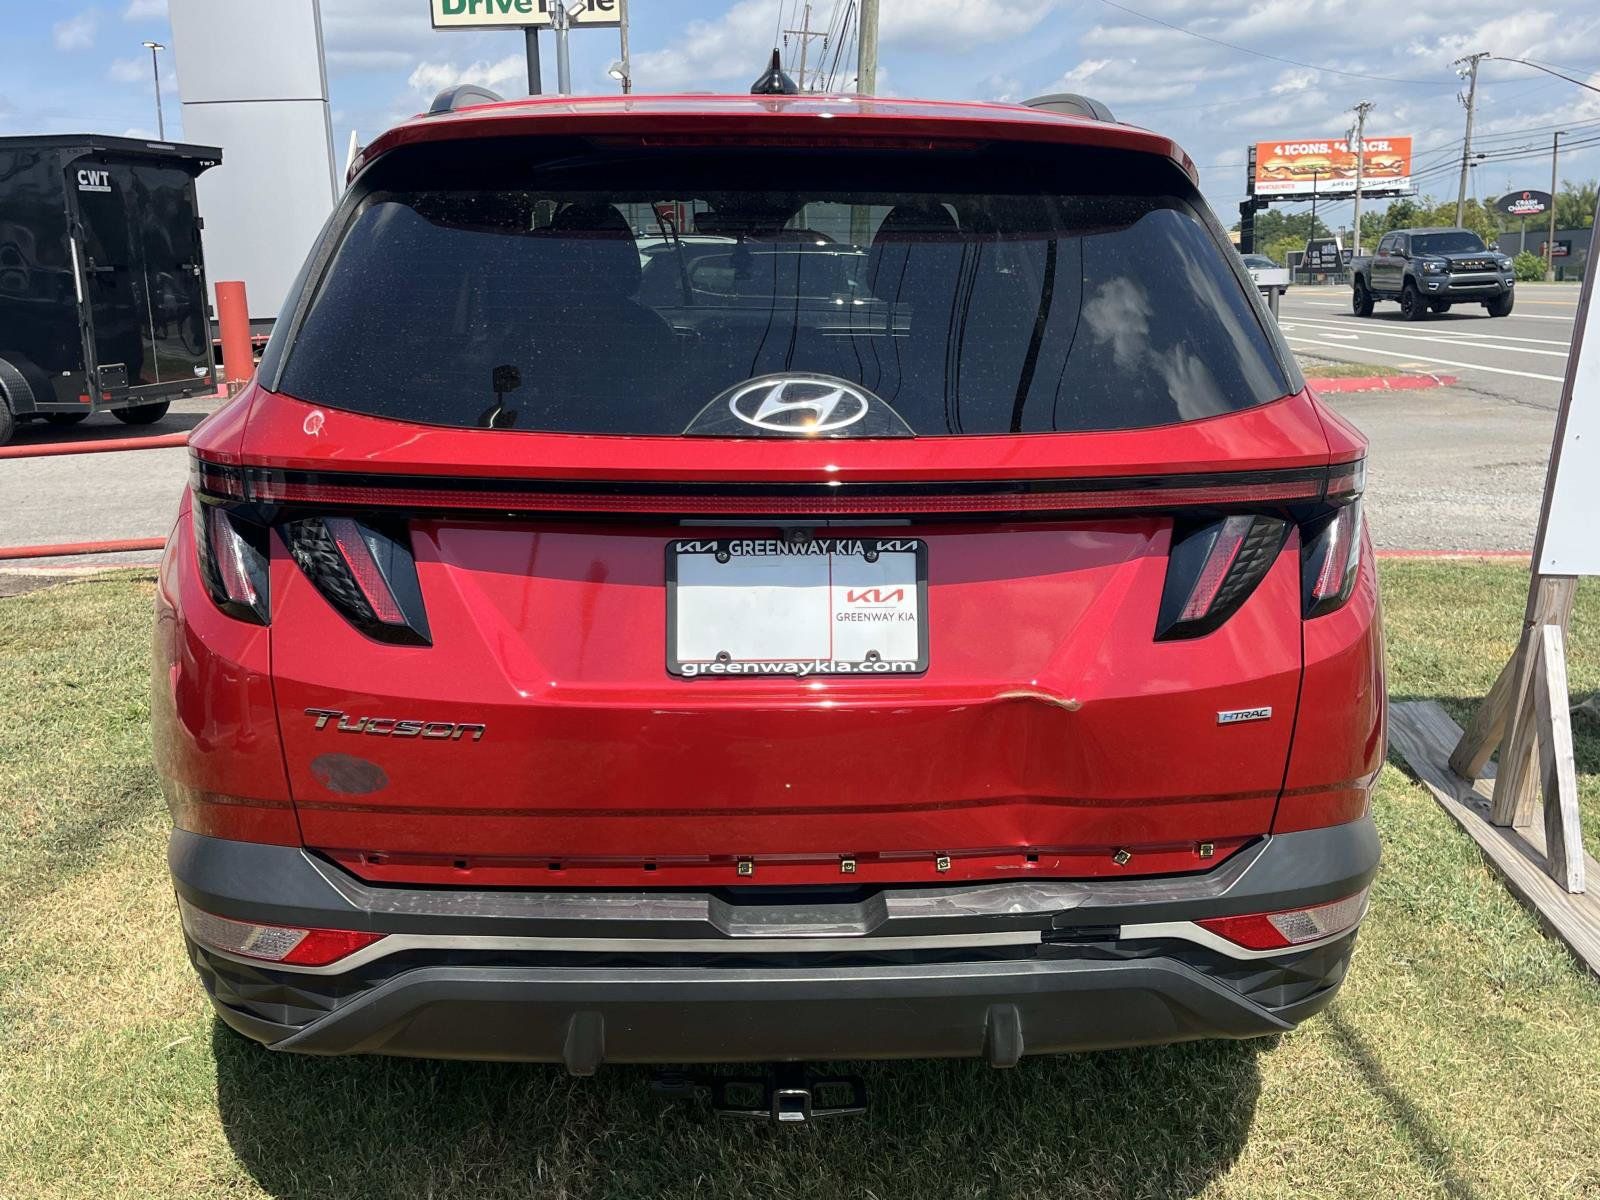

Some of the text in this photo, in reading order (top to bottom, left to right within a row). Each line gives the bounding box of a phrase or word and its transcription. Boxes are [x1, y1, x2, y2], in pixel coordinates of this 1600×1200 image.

[1285, 143, 1332, 155] ICONS.
[77, 169, 109, 186] CWT
[728, 540, 831, 556] GREENWAY
[836, 540, 865, 555] KIA
[836, 612, 915, 622] GREENWAY KIA
[681, 660, 917, 677] greenwaykia.com
[1223, 709, 1268, 720] HTRAC
